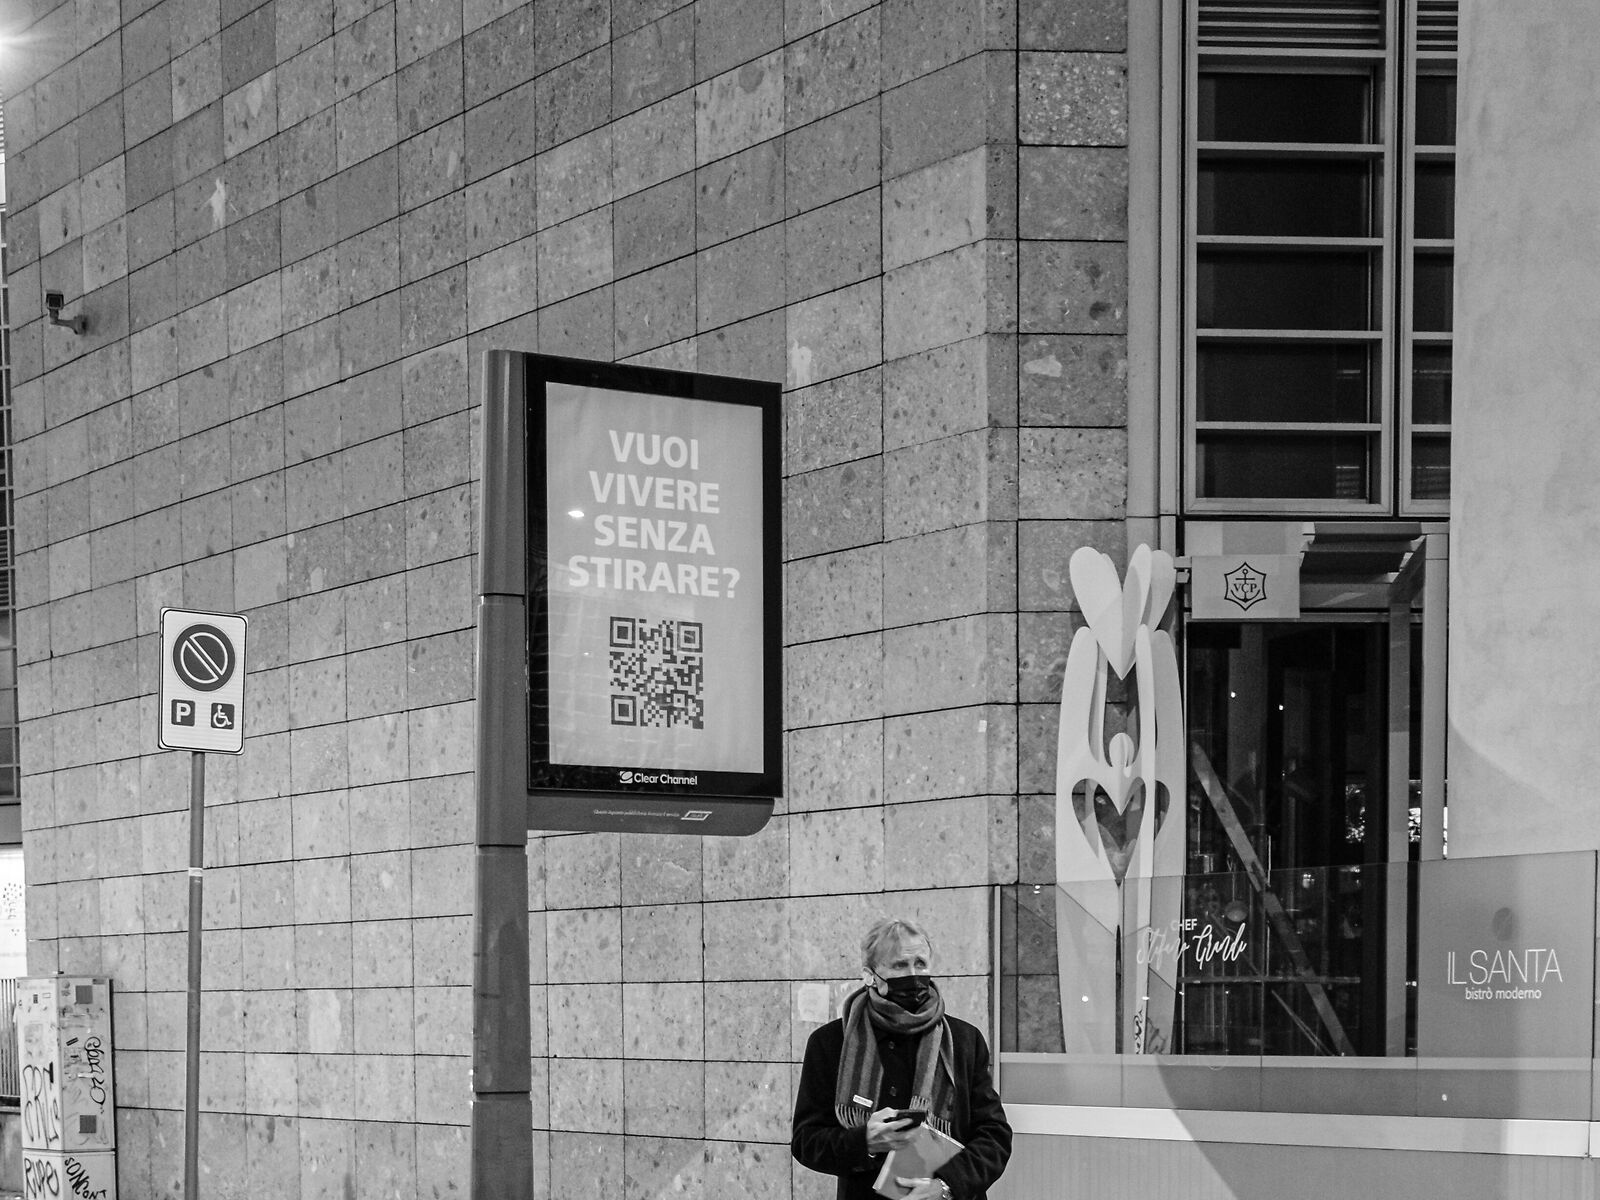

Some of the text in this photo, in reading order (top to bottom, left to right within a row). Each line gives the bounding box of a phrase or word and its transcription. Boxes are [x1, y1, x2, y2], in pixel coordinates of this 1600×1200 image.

[608, 429, 699, 471] VUOI
[588, 470, 720, 514] VIVERE
[593, 514, 716, 555] SENZA
[568, 555, 741, 599] STIRARE?
[1233, 583, 1257, 593] VCP
[176, 702, 191, 723] P
[633, 772, 698, 786] Clear Channel
[1170, 918, 1198, 931] CHEF
[1469, 948, 1564, 985] SANTA
[1465, 986, 1542, 1001] bistrò moderno
